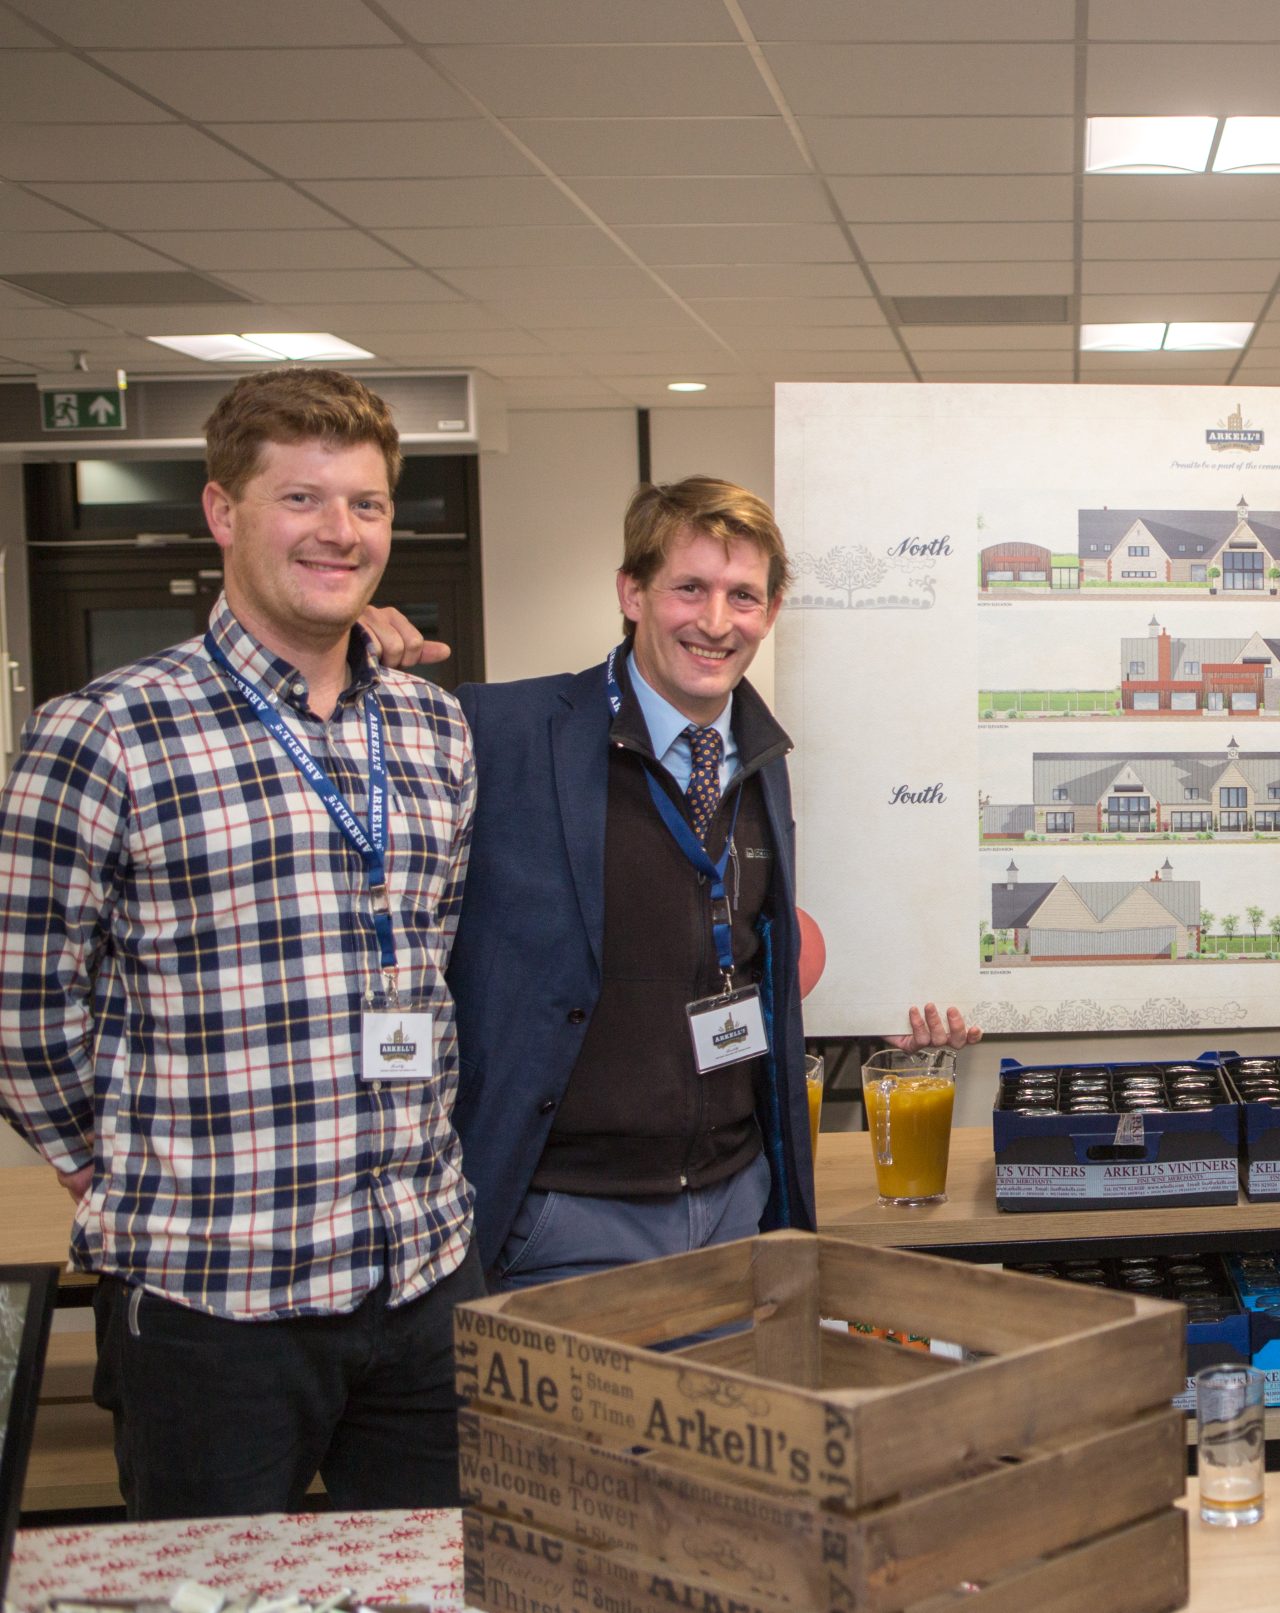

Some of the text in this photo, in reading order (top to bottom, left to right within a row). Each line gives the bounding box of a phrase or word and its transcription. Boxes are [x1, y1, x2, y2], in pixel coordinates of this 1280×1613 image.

[1208, 431, 1261, 441] ARKELL'S
[887, 535, 953, 556] North
[274, 723, 324, 780] ARKELL'S
[369, 712, 382, 772] ARKELL'S
[371, 785, 384, 851] ARKELL'S
[888, 782, 947, 805] South
[328, 794, 373, 852] ARKELL'S
[996, 1166, 1086, 1177] L'S VINTNERS
[1104, 1160, 1236, 1177] ARKELL'S VINTNERS
[455, 1308, 636, 1374] Welcome Tower
[482, 1351, 560, 1414] Ale
[586, 1371, 635, 1400] Steam
[588, 1399, 637, 1430] Time
[643, 1397, 811, 1485] Arkell's
[460, 1452, 561, 1506] Welcome
[567, 1485, 638, 1530] Tower
[483, 1428, 560, 1479] Thirst
[567, 1455, 642, 1505] Local
